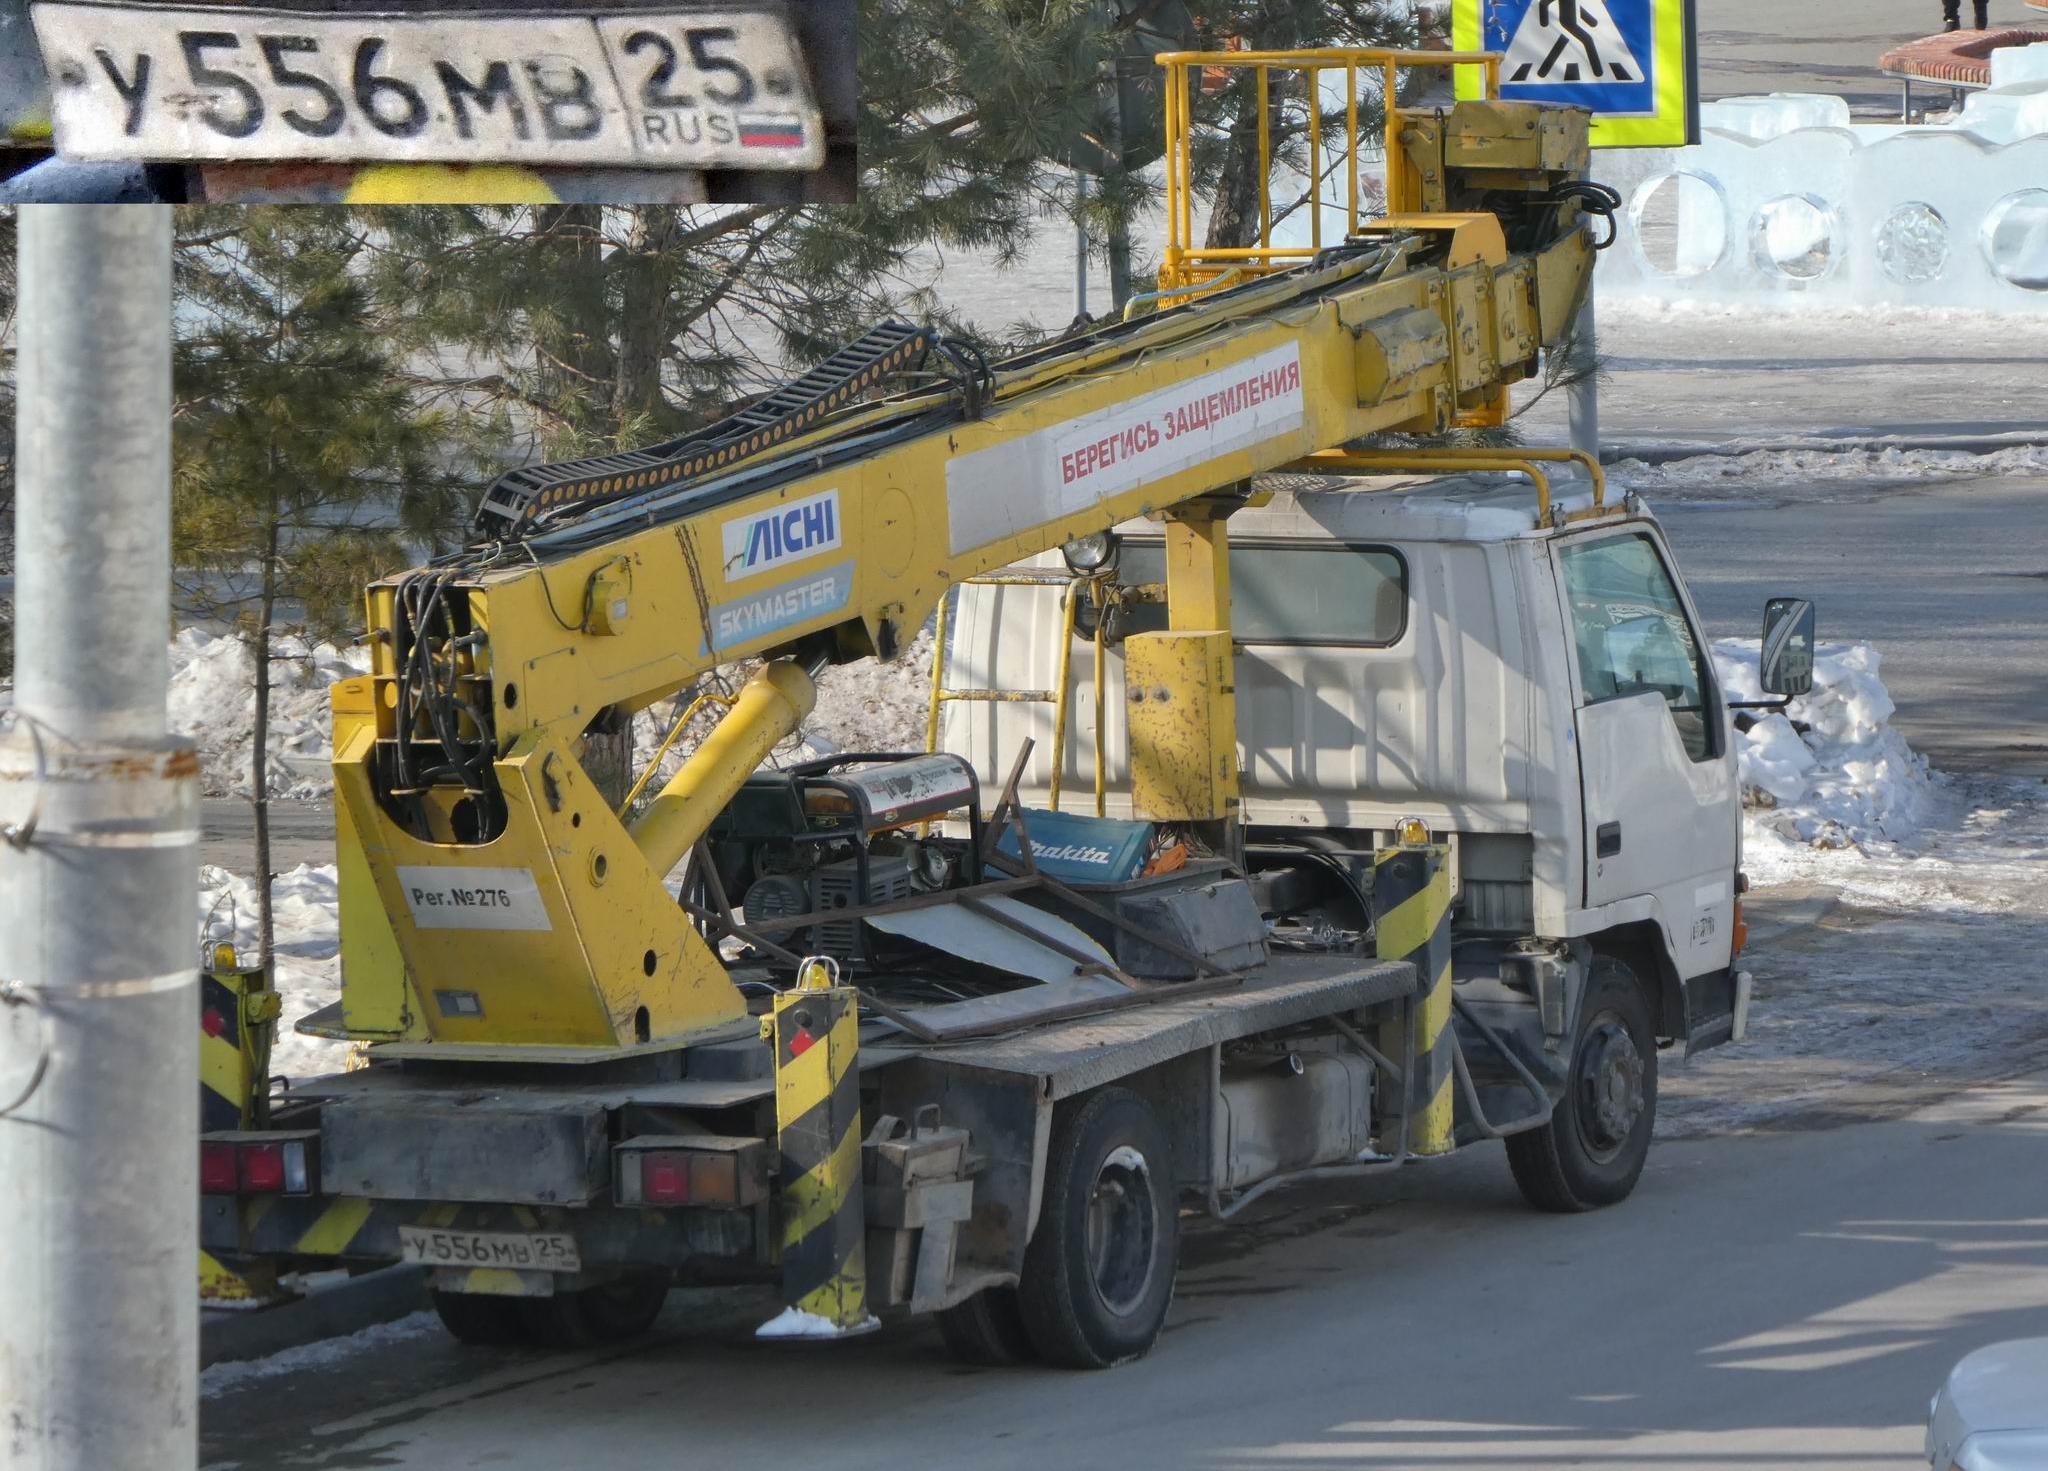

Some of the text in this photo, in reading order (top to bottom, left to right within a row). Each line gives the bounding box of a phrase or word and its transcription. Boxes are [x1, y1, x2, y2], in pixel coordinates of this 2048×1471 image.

[624, 27, 756, 109] 25
[642, 112, 735, 146] RUS
[1062, 360, 1300, 484] БЕРЕГИСЬ ЗАЩЕМЛЕНИЯ
[742, 499, 834, 568] AICHI
[719, 577, 836, 639] SKYMASTER
[535, 1237, 566, 1257] 25
